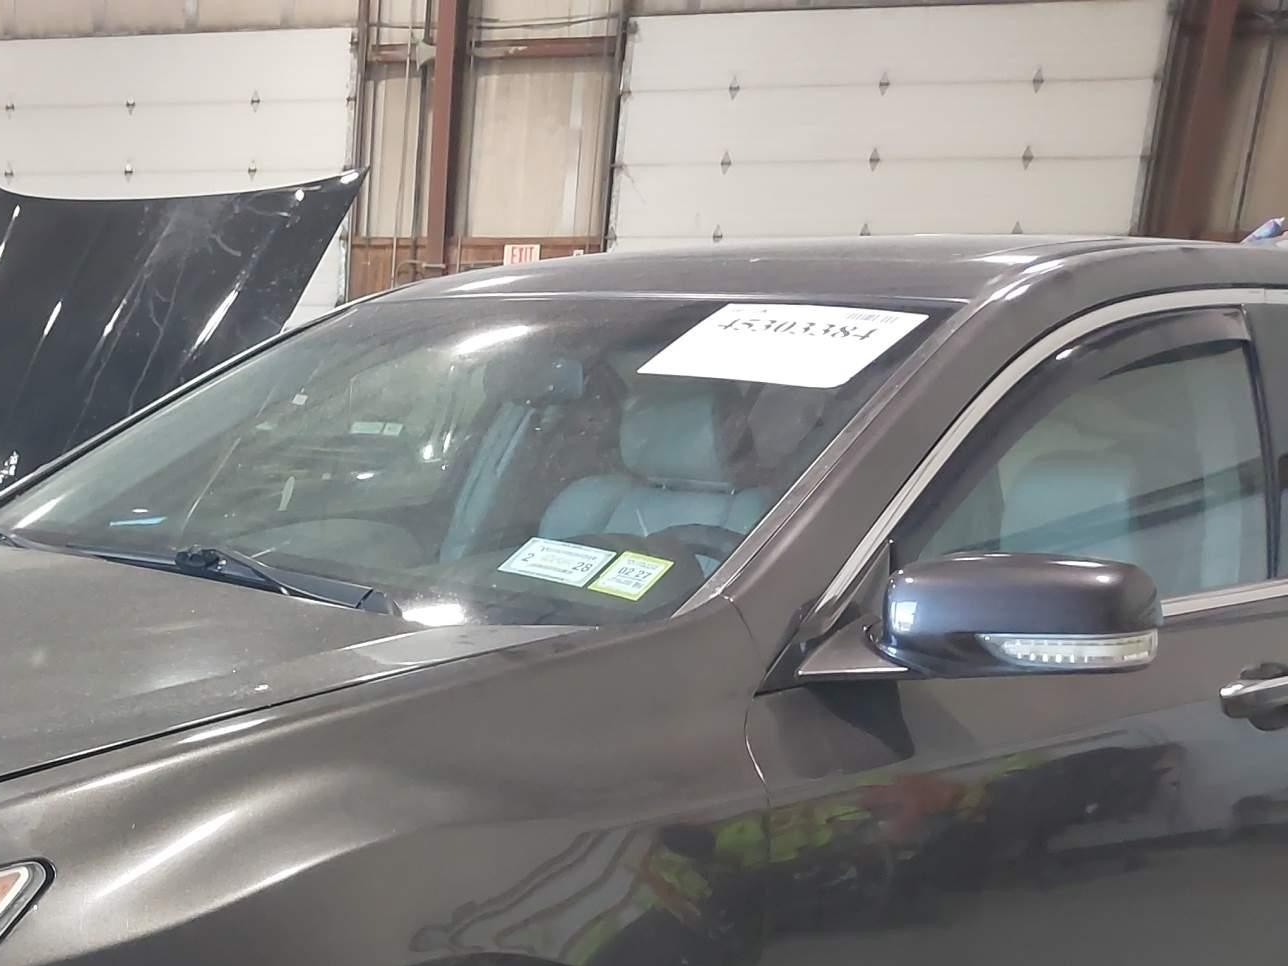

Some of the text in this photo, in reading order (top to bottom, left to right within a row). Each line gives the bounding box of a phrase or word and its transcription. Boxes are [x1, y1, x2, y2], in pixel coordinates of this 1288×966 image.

[510, 245, 535, 264] EXIT
[718, 318, 878, 341] 45303384
[520, 552, 535, 562] 2
[570, 561, 593, 573] 28
[617, 567, 653, 580] 02 27
